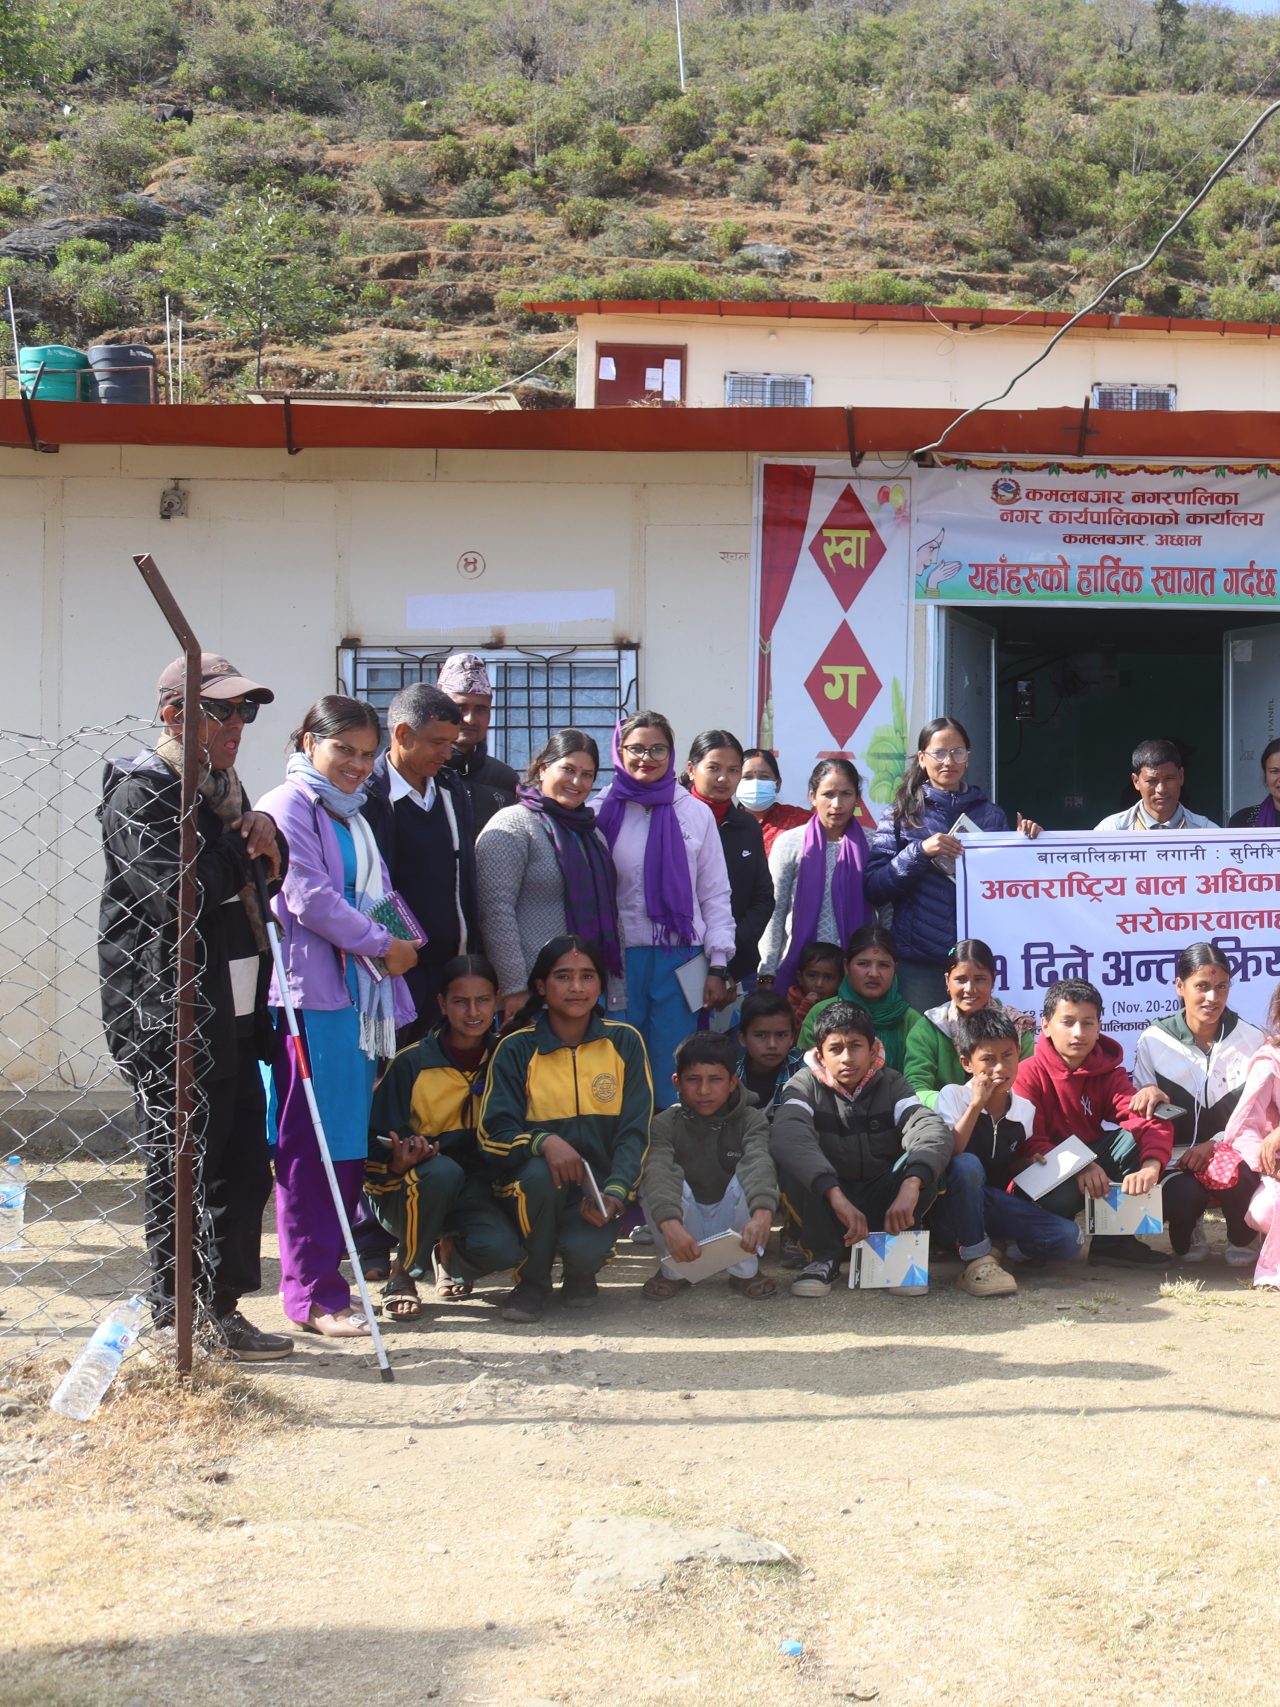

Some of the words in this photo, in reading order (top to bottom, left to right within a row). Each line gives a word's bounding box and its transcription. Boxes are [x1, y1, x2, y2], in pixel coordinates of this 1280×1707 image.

[1025, 488, 1125, 505] कमलबजार
[1131, 487, 1240, 506] नगरपालिका
[1000, 509, 1043, 524] नगर
[1048, 507, 1180, 526] कार्यपालिकाको
[1186, 509, 1265, 527] कार्यालय
[822, 528, 871, 576] स्वा
[1154, 533, 1202, 547] अछाम
[1077, 554, 1144, 596] हार्दिक
[1150, 566, 1217, 597] स्वागत
[1223, 560, 1278, 599] गर्दछ
[821, 665, 867, 709] ग
[1037, 847, 1147, 864] बालबालिकामा
[1157, 845, 1207, 861] लगानी
[979, 871, 1127, 902] अन्तराष्ट्रिय
[1135, 876, 1187, 896] बाल
[1021, 942, 1094, 991] दिने
[1112, 1001, 1143, 1016] (Nov.
